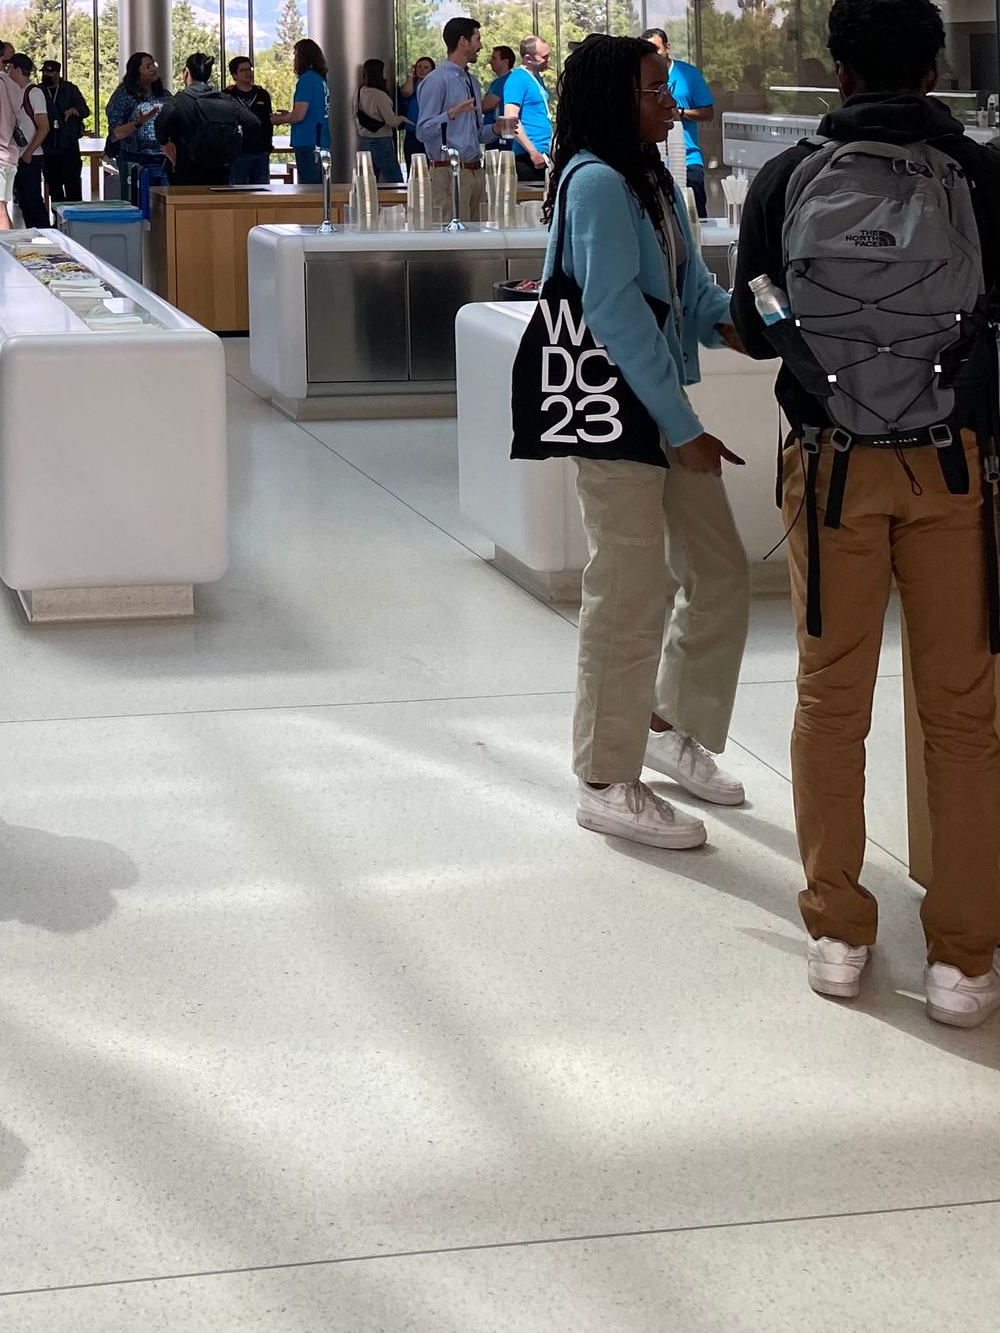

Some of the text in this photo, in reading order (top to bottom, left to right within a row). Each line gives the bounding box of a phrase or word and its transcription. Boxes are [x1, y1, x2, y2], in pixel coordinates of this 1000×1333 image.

[539, 299, 605, 348] W
[541, 346, 618, 393] DC
[540, 394, 623, 443] 23
